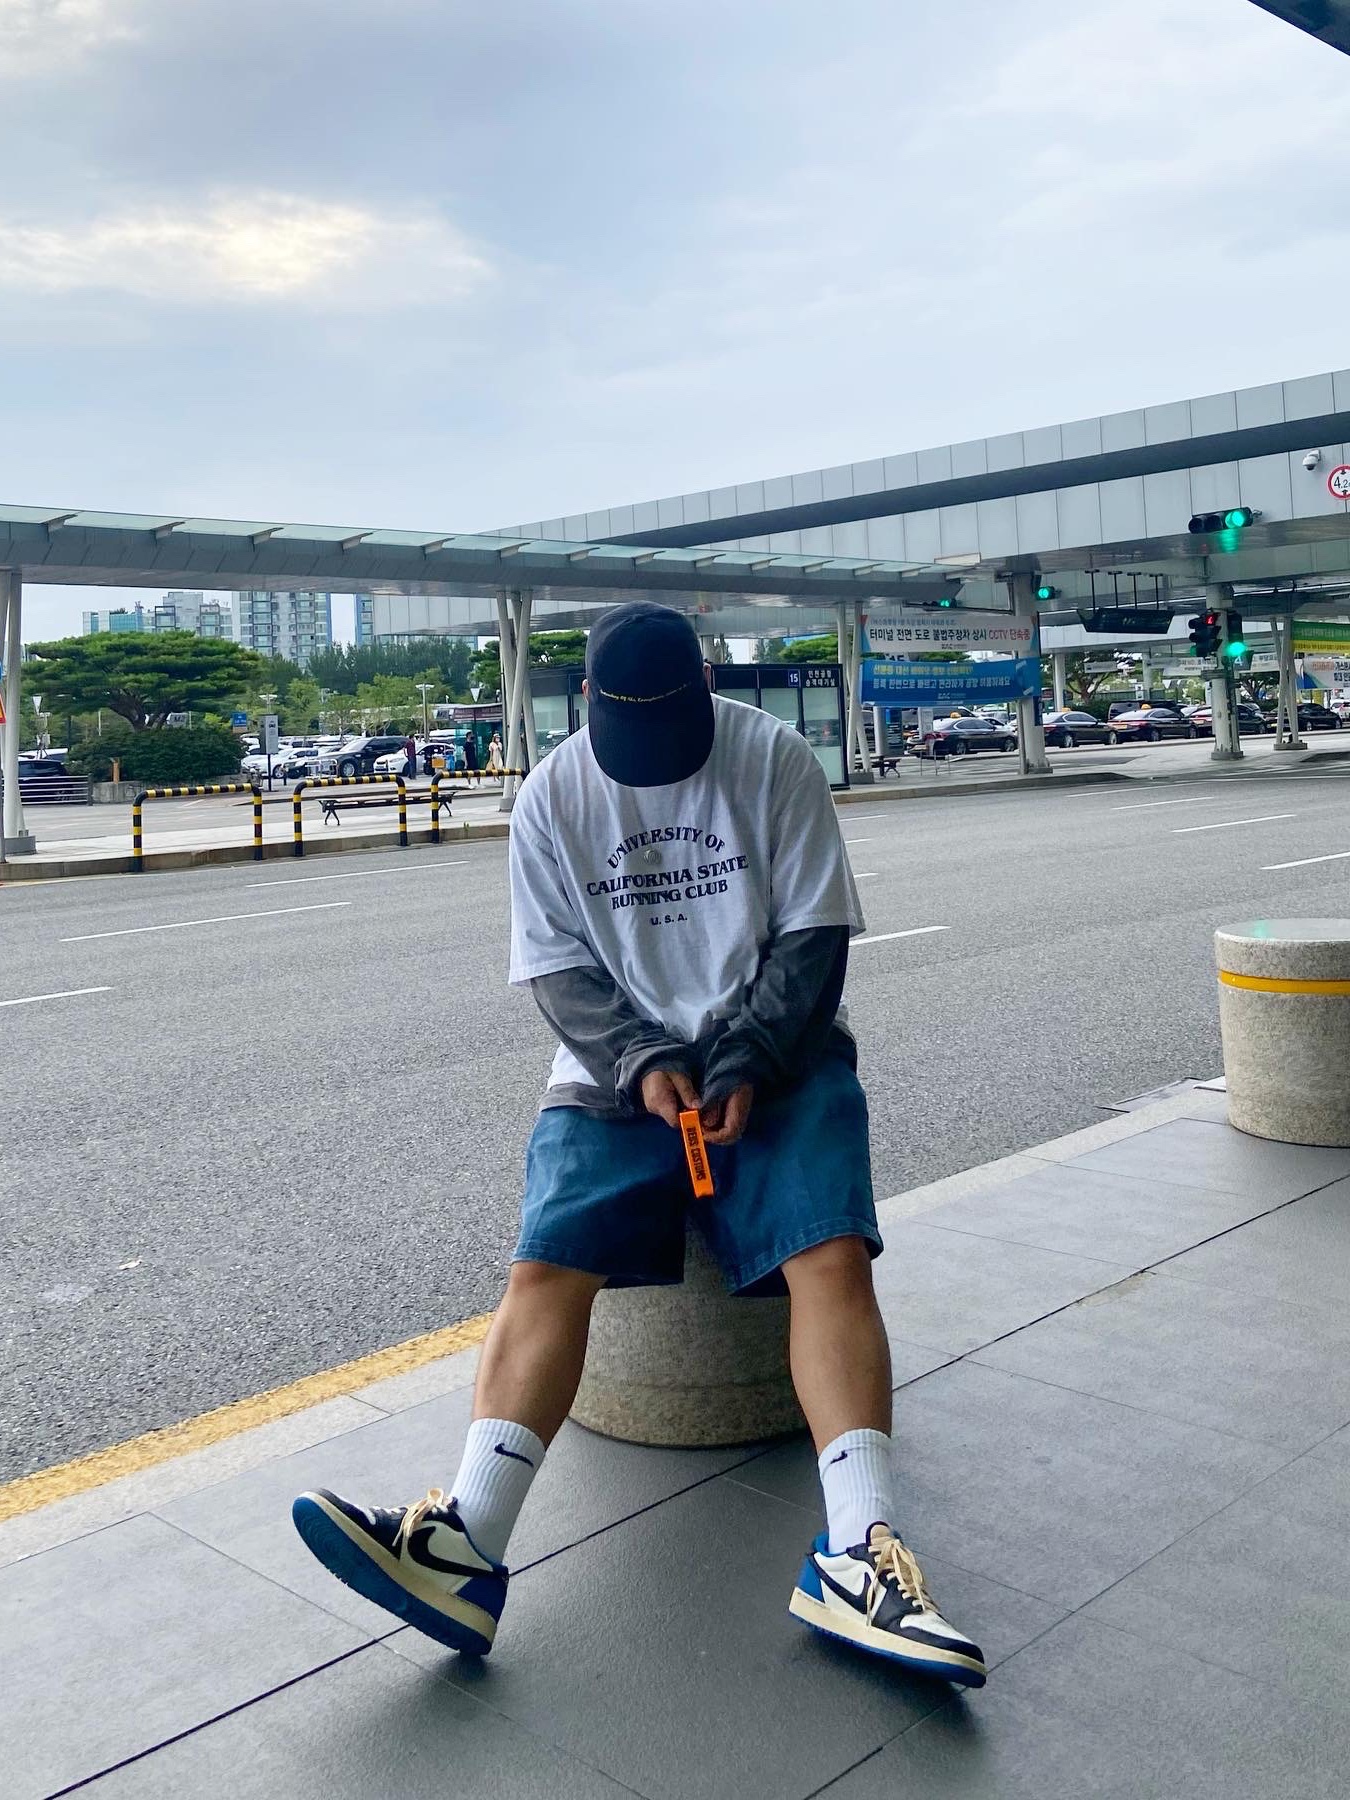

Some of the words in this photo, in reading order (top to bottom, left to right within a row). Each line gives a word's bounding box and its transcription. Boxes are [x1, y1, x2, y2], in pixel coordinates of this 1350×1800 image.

[869, 628, 894, 641] 터미널
[896, 628, 912, 641] 전면
[914, 628, 931, 641] 도로
[972, 628, 987, 641] 상시
[988, 628, 1008, 641] CCTV
[1009, 628, 1031, 641] 단속중
[790, 673, 799, 683] 15
[607, 826, 703, 869] UNIVERSITY
[704, 834, 726, 853] OF
[587, 868, 694, 897] CALIFORNIA
[697, 855, 750, 880] STATE
[612, 888, 682, 910] RUNNING
[685, 879, 728, 900] CLUB
[691, 1147, 707, 1181] CUSTOMS
